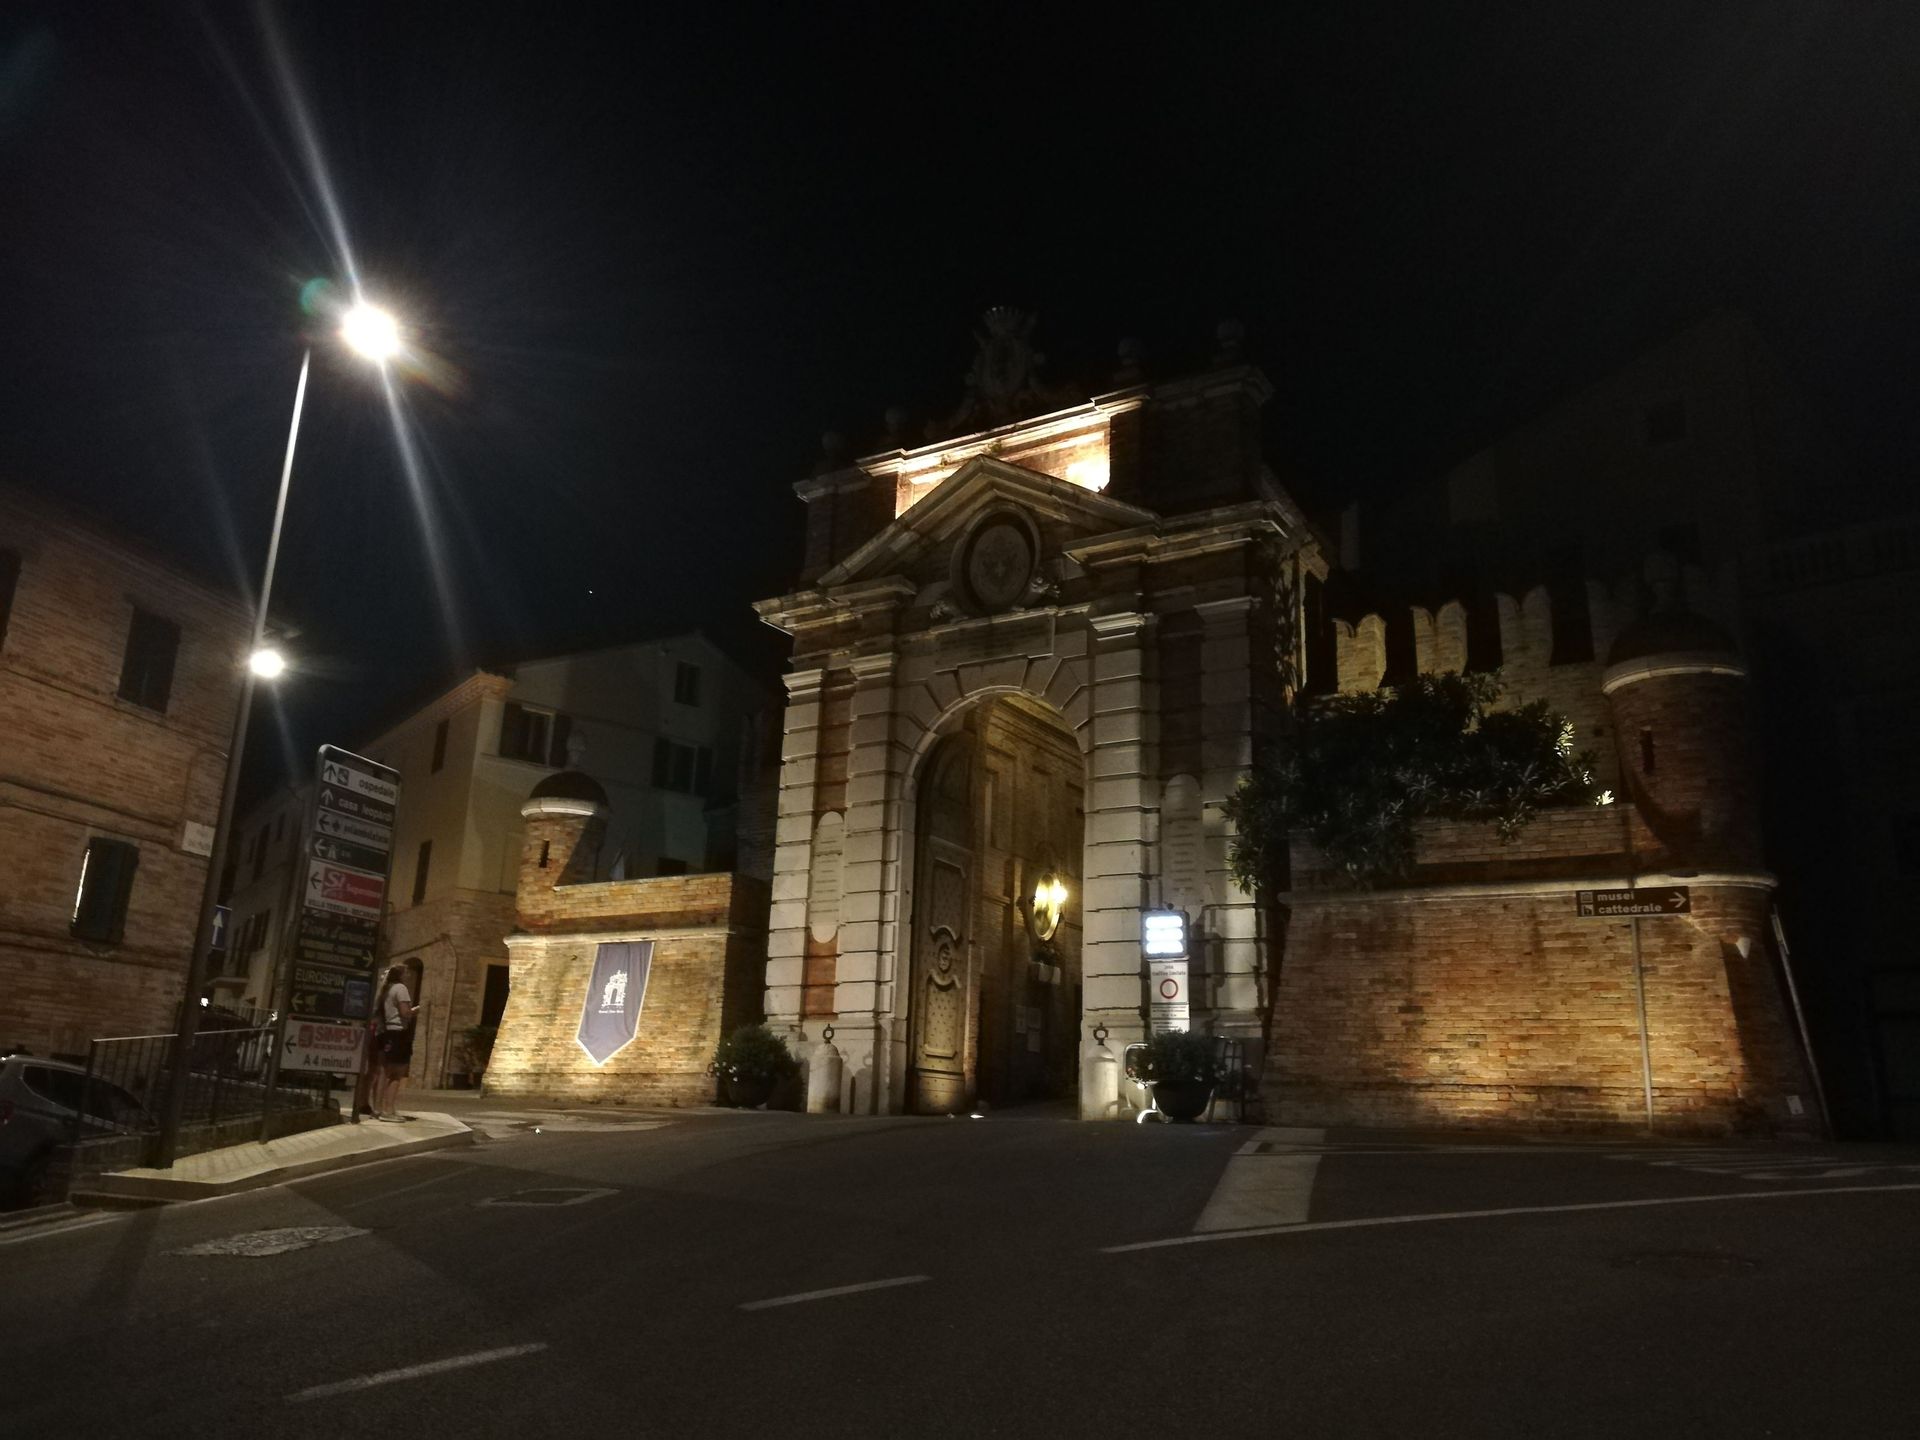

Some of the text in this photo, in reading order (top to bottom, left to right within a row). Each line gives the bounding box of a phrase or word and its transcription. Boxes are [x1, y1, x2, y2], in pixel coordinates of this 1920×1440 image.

[359, 779, 395, 798] ospedale
[339, 797, 358, 811] casa
[1597, 890, 1635, 902] musei
[1598, 903, 1663, 915] cattedrale
[295, 967, 345, 988] EUROSPIN
[303, 1053, 352, 1069] A 4 minuti
